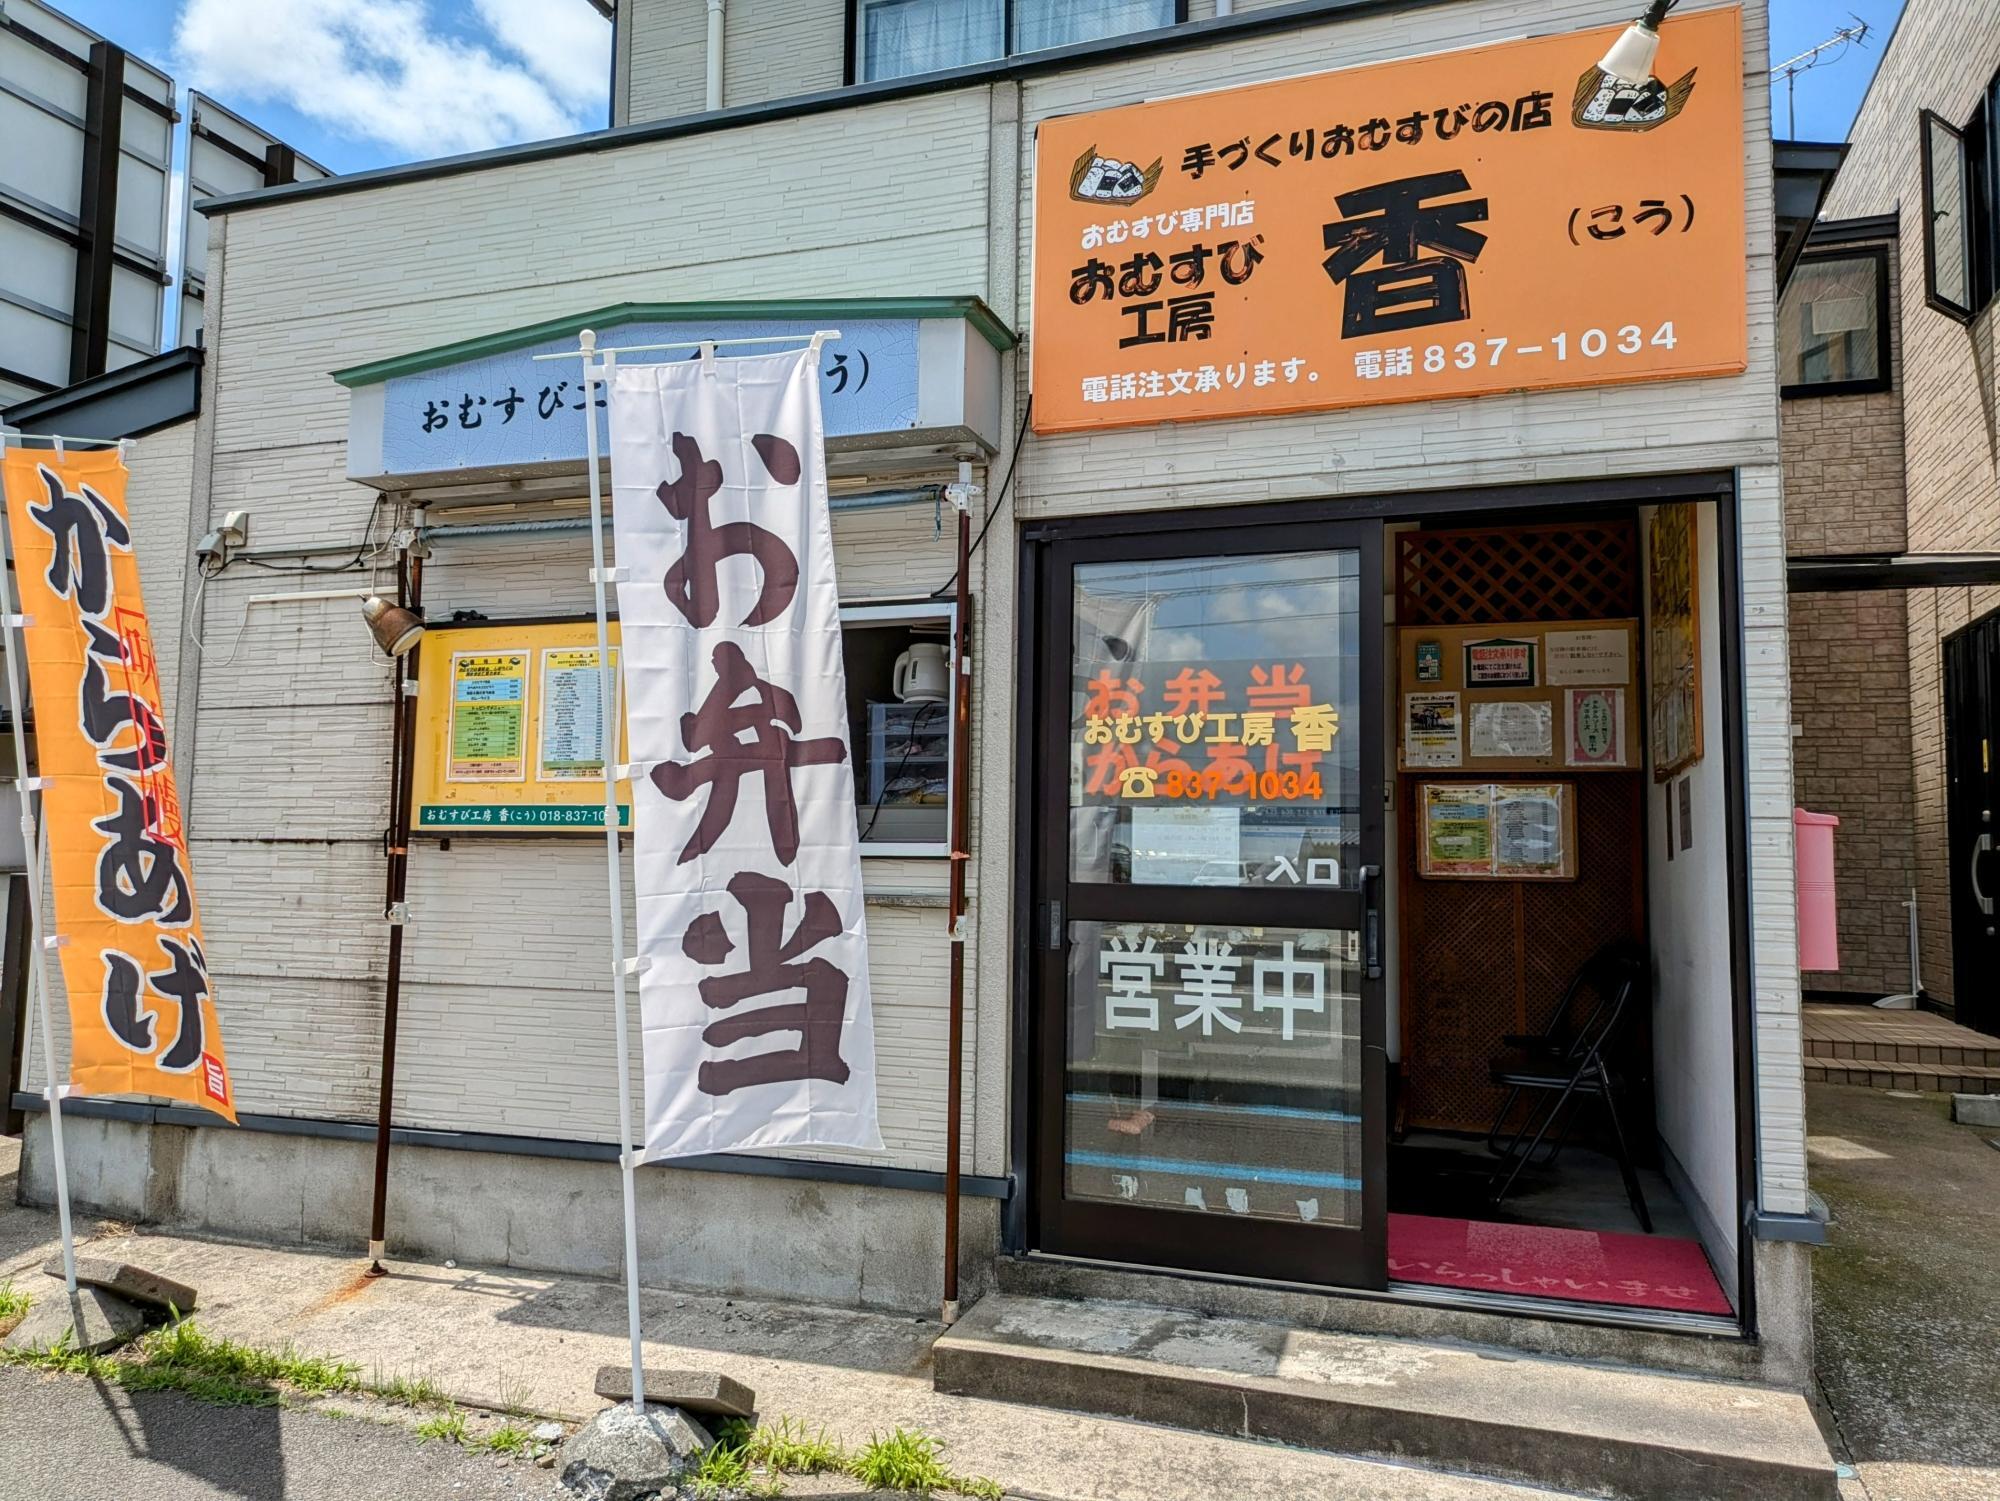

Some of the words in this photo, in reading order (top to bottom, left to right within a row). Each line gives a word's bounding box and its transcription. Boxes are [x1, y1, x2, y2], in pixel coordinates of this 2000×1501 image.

[1180, 90, 1555, 180] 手づくりおむすびの店
[1082, 200, 1257, 250] おむすび専門店
[1069, 233, 1265, 305] おむすび
[1322, 169, 1490, 341] 香
[1567, 194, 1696, 246] （こう）
[1118, 291, 1215, 349] 工房
[1081, 357, 1321, 404] 電話注文承ります。
[1084, 663, 1311, 719] お弁当
[1084, 711, 1276, 746] おむすび工房
[1290, 704, 1339, 752] 香
[26, 463, 209, 1076] からあげ
[650, 431, 850, 1096] お弁当
[426, 808, 493, 822] おむすび工房
[1265, 855, 1340, 886] 入口
[1100, 934, 1325, 1040] 営業中
[1387, 1258, 1700, 1300] いらっしゃいませ
